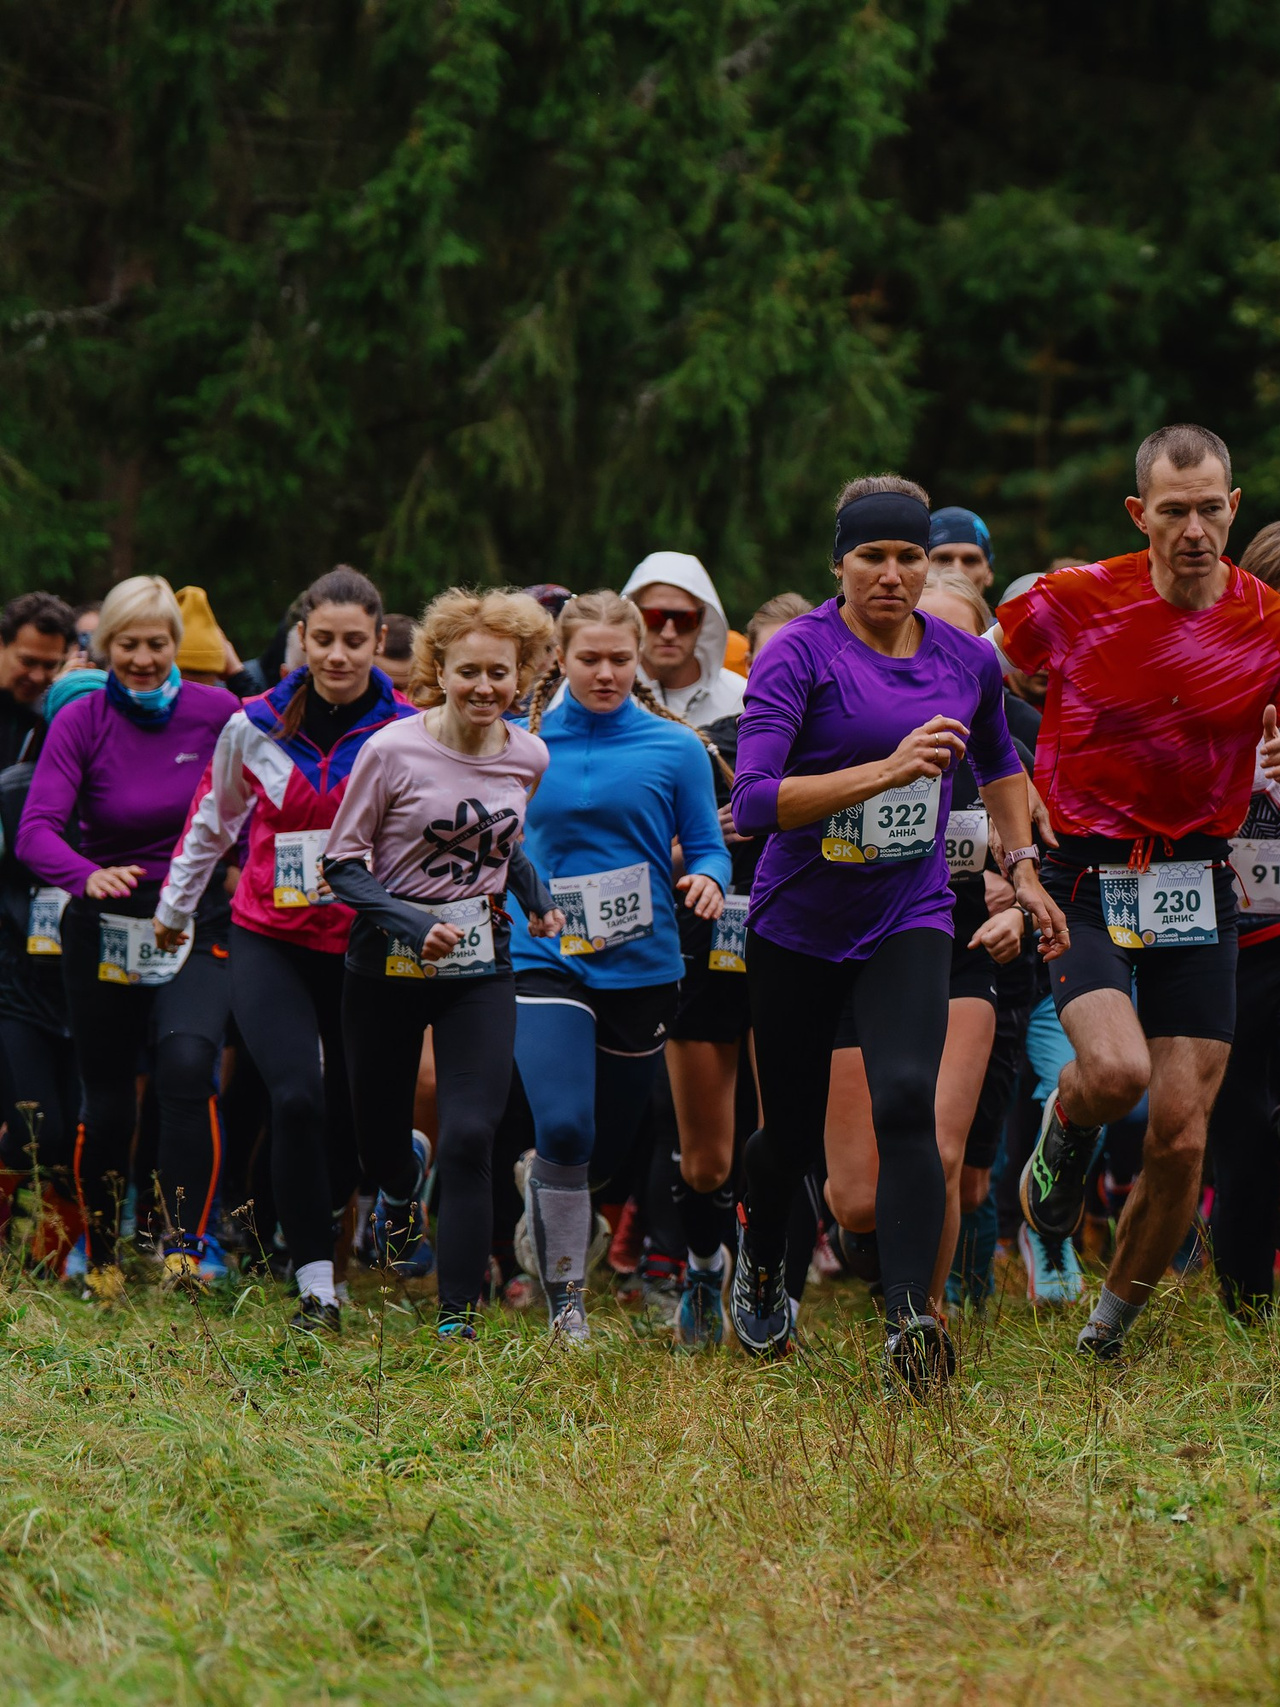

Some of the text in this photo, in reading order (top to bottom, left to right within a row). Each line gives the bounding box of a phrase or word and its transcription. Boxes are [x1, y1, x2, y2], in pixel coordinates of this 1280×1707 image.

[878, 803, 927, 829] 322
[888, 828, 917, 838] АННА
[599, 892, 641, 921] 582
[1153, 889, 1201, 913] 230
[606, 913, 638, 928] ТАИСИЯ
[1162, 914, 1194, 924] ДЕНИС
